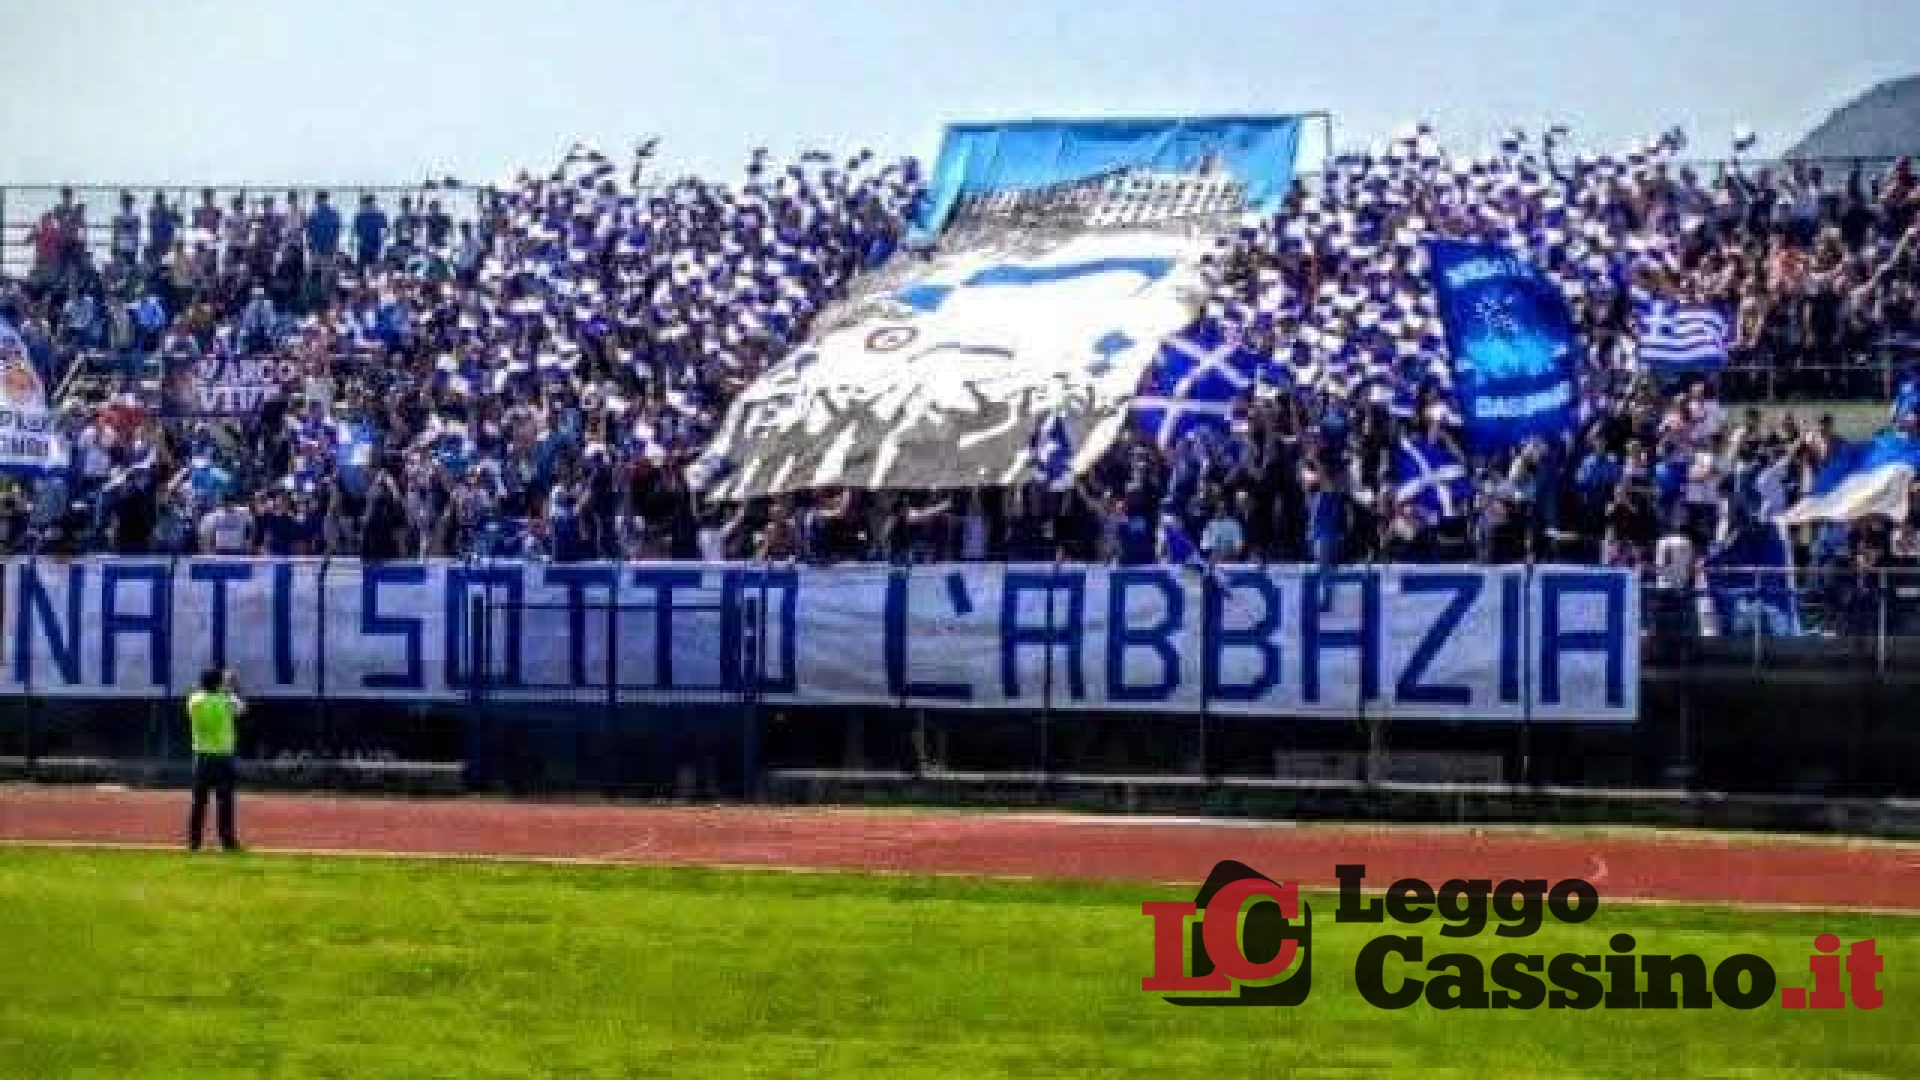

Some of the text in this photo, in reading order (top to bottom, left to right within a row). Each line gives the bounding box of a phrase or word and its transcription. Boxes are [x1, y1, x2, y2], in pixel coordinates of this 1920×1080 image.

[14, 564, 1626, 707] NATI SOTTO L'ABBAZIA
